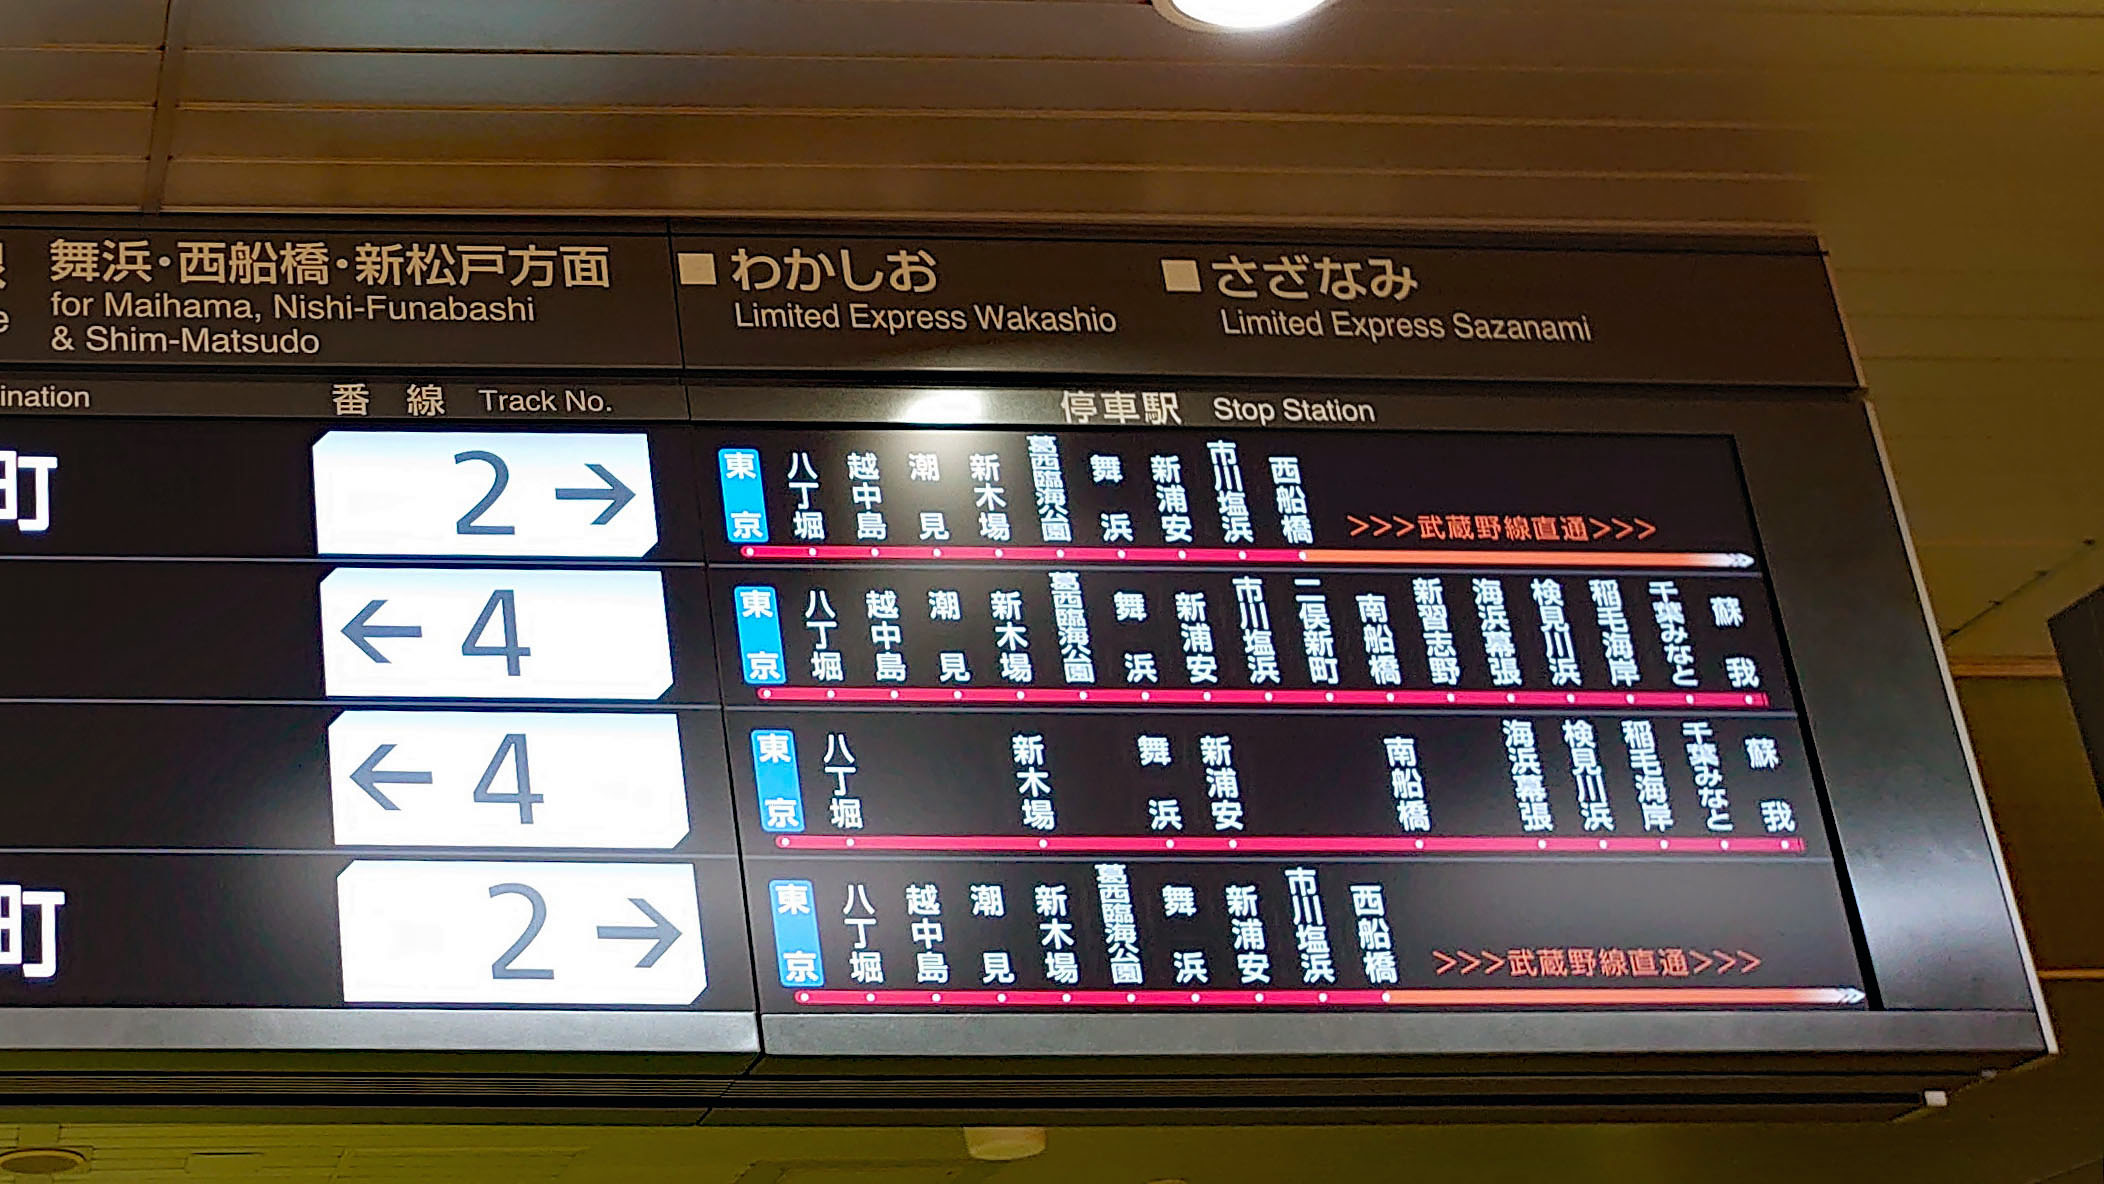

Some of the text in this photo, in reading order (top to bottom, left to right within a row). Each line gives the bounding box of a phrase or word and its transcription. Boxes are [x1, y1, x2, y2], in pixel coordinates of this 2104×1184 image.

[50, 238, 610, 288] 舞浜・西船橋・新松戸方面
[50, 290, 535, 323] for Maihama, Nishi-Funabashi
[730, 248, 937, 293] わかしお
[1211, 254, 1418, 301] さざなみ
[51, 325, 320, 354] & Shim-Matsudo
[734, 302, 1117, 336] Limited Express Wakashio
[1220, 308, 1592, 343] Limited Express Sazanami
[478, 389, 558, 412] Track
[565, 390, 612, 412] No.
[1059, 390, 1376, 426] 停車駅 Stop Station
[453, 449, 516, 536] 2
[723, 452, 765, 541] 東京
[787, 452, 825, 540] 八丁堀
[847, 452, 887, 540] 越中島
[907, 452, 952, 541] 潮見
[968, 452, 1012, 542] 新木場
[1089, 454, 1134, 542] 舞浜
[1150, 454, 1193, 543] 新浦安
[1206, 439, 1254, 543] 市川塩浜
[1268, 456, 1314, 544] 西船橋
[461, 588, 532, 677] 4
[739, 589, 783, 683] 東京
[805, 590, 844, 681] 八丁堀
[865, 590, 907, 682] 越中島
[928, 590, 971, 682] 潮見
[990, 590, 1032, 683] 新木場
[1113, 591, 1158, 683] 舞浜
[1174, 591, 1218, 683] 新浦安
[1232, 575, 1281, 684] 市川塩浜
[1294, 578, 1339, 685] 二俣新町
[1355, 593, 1402, 685] 南船橋
[1412, 577, 1461, 685] 新習志野
[1472, 577, 1523, 686] 海浜幕張
[1530, 578, 1582, 686] 検見川浜
[1588, 579, 1641, 687] 稲毛海岸
[1648, 580, 1699, 687] 千葉みなと
[1709, 596, 1760, 688] 蘇我
[472, 733, 545, 825] 4
[757, 733, 802, 830] 東京
[823, 734, 863, 829] 八丁堀
[1012, 734, 1055, 830] 新木場
[1137, 735, 1183, 830] 舞浜
[1200, 735, 1244, 831] 新浦安
[1383, 736, 1431, 832] 南船橋
[1502, 719, 1554, 832] 海浜幕張
[1561, 719, 1615, 831] 検見川浜
[1621, 720, 1674, 832] 稲毛海岸
[1682, 721, 1733, 831] 千葉みなと
[1744, 737, 1796, 832] 蘇我
[488, 882, 555, 981] 2
[775, 883, 820, 985] 東京
[842, 884, 884, 983] 八丁堀
[905, 884, 949, 983] 越中島
[970, 884, 1015, 984] 潮見
[1034, 884, 1079, 984] 新木場
[1161, 884, 1209, 984] 舞浜
[1225, 884, 1271, 984] 新浦安
[1284, 866, 1336, 984] 市川塩浜
[1350, 885, 1398, 984] 西船橋
